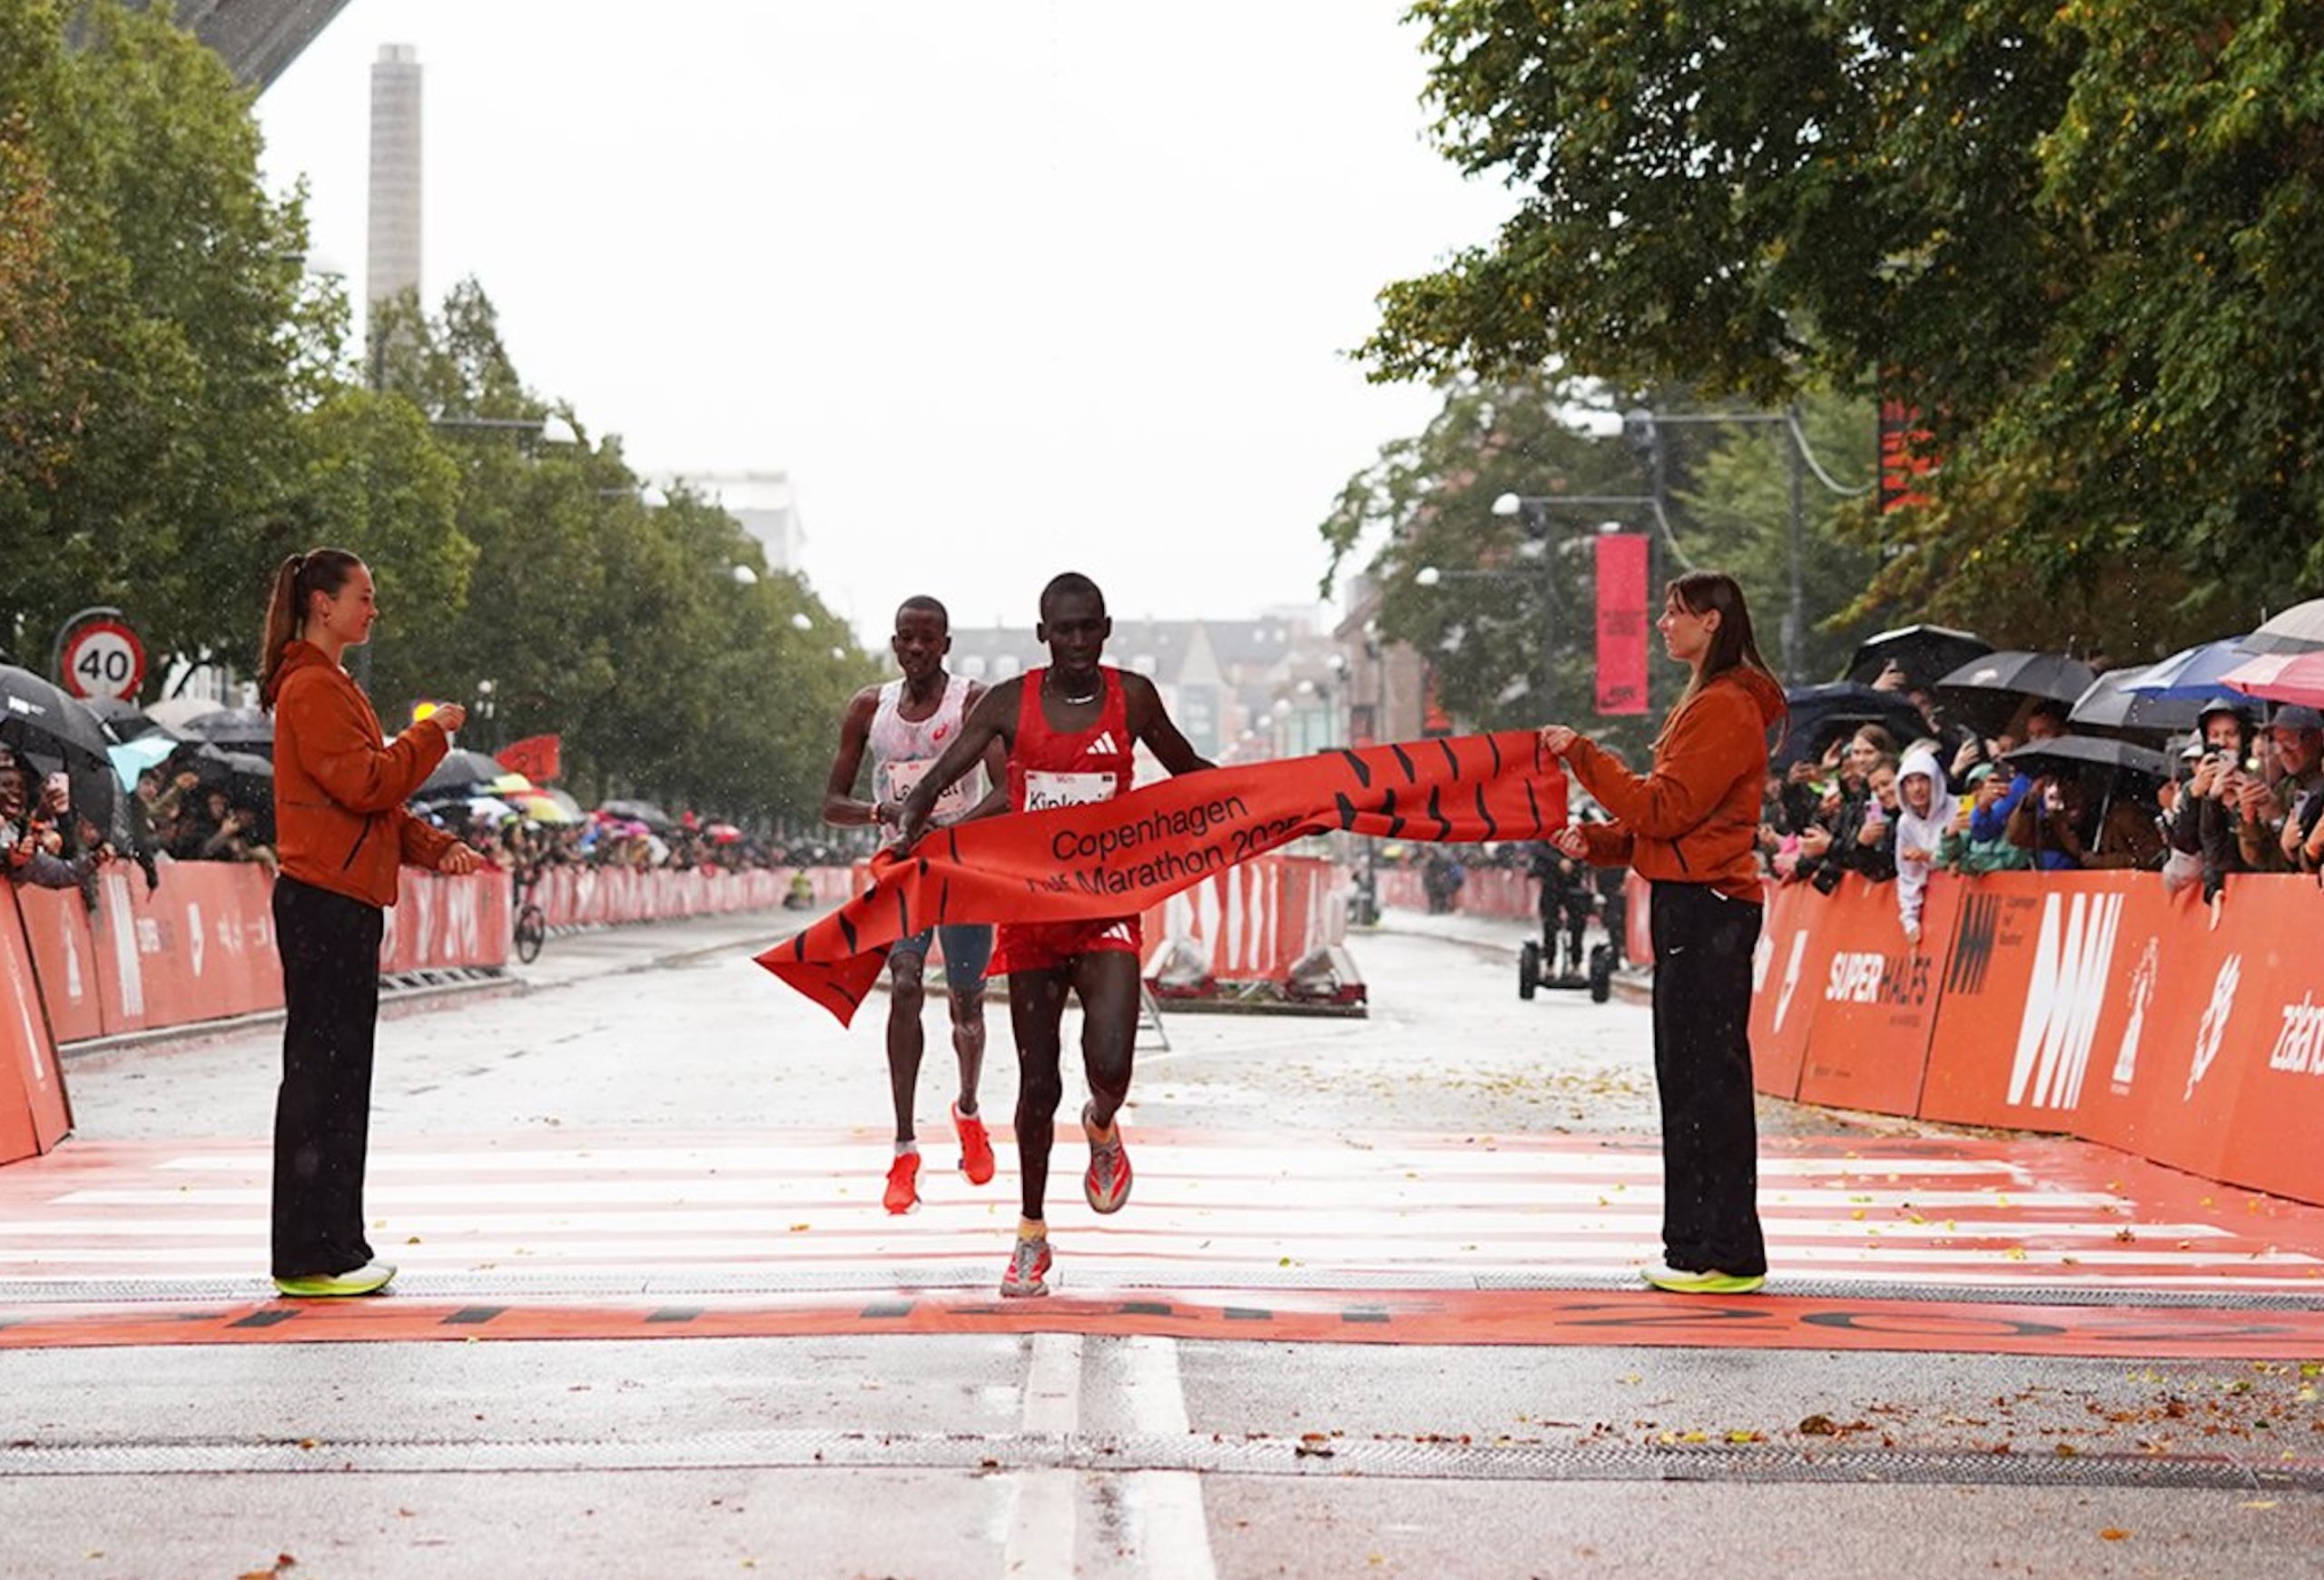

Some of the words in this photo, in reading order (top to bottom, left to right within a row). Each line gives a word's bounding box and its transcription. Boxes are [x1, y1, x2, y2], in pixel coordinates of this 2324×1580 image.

[78, 648, 129, 682] 40
[1051, 795, 1248, 861] Copenhagen
[1076, 844, 1226, 895] Marathon
